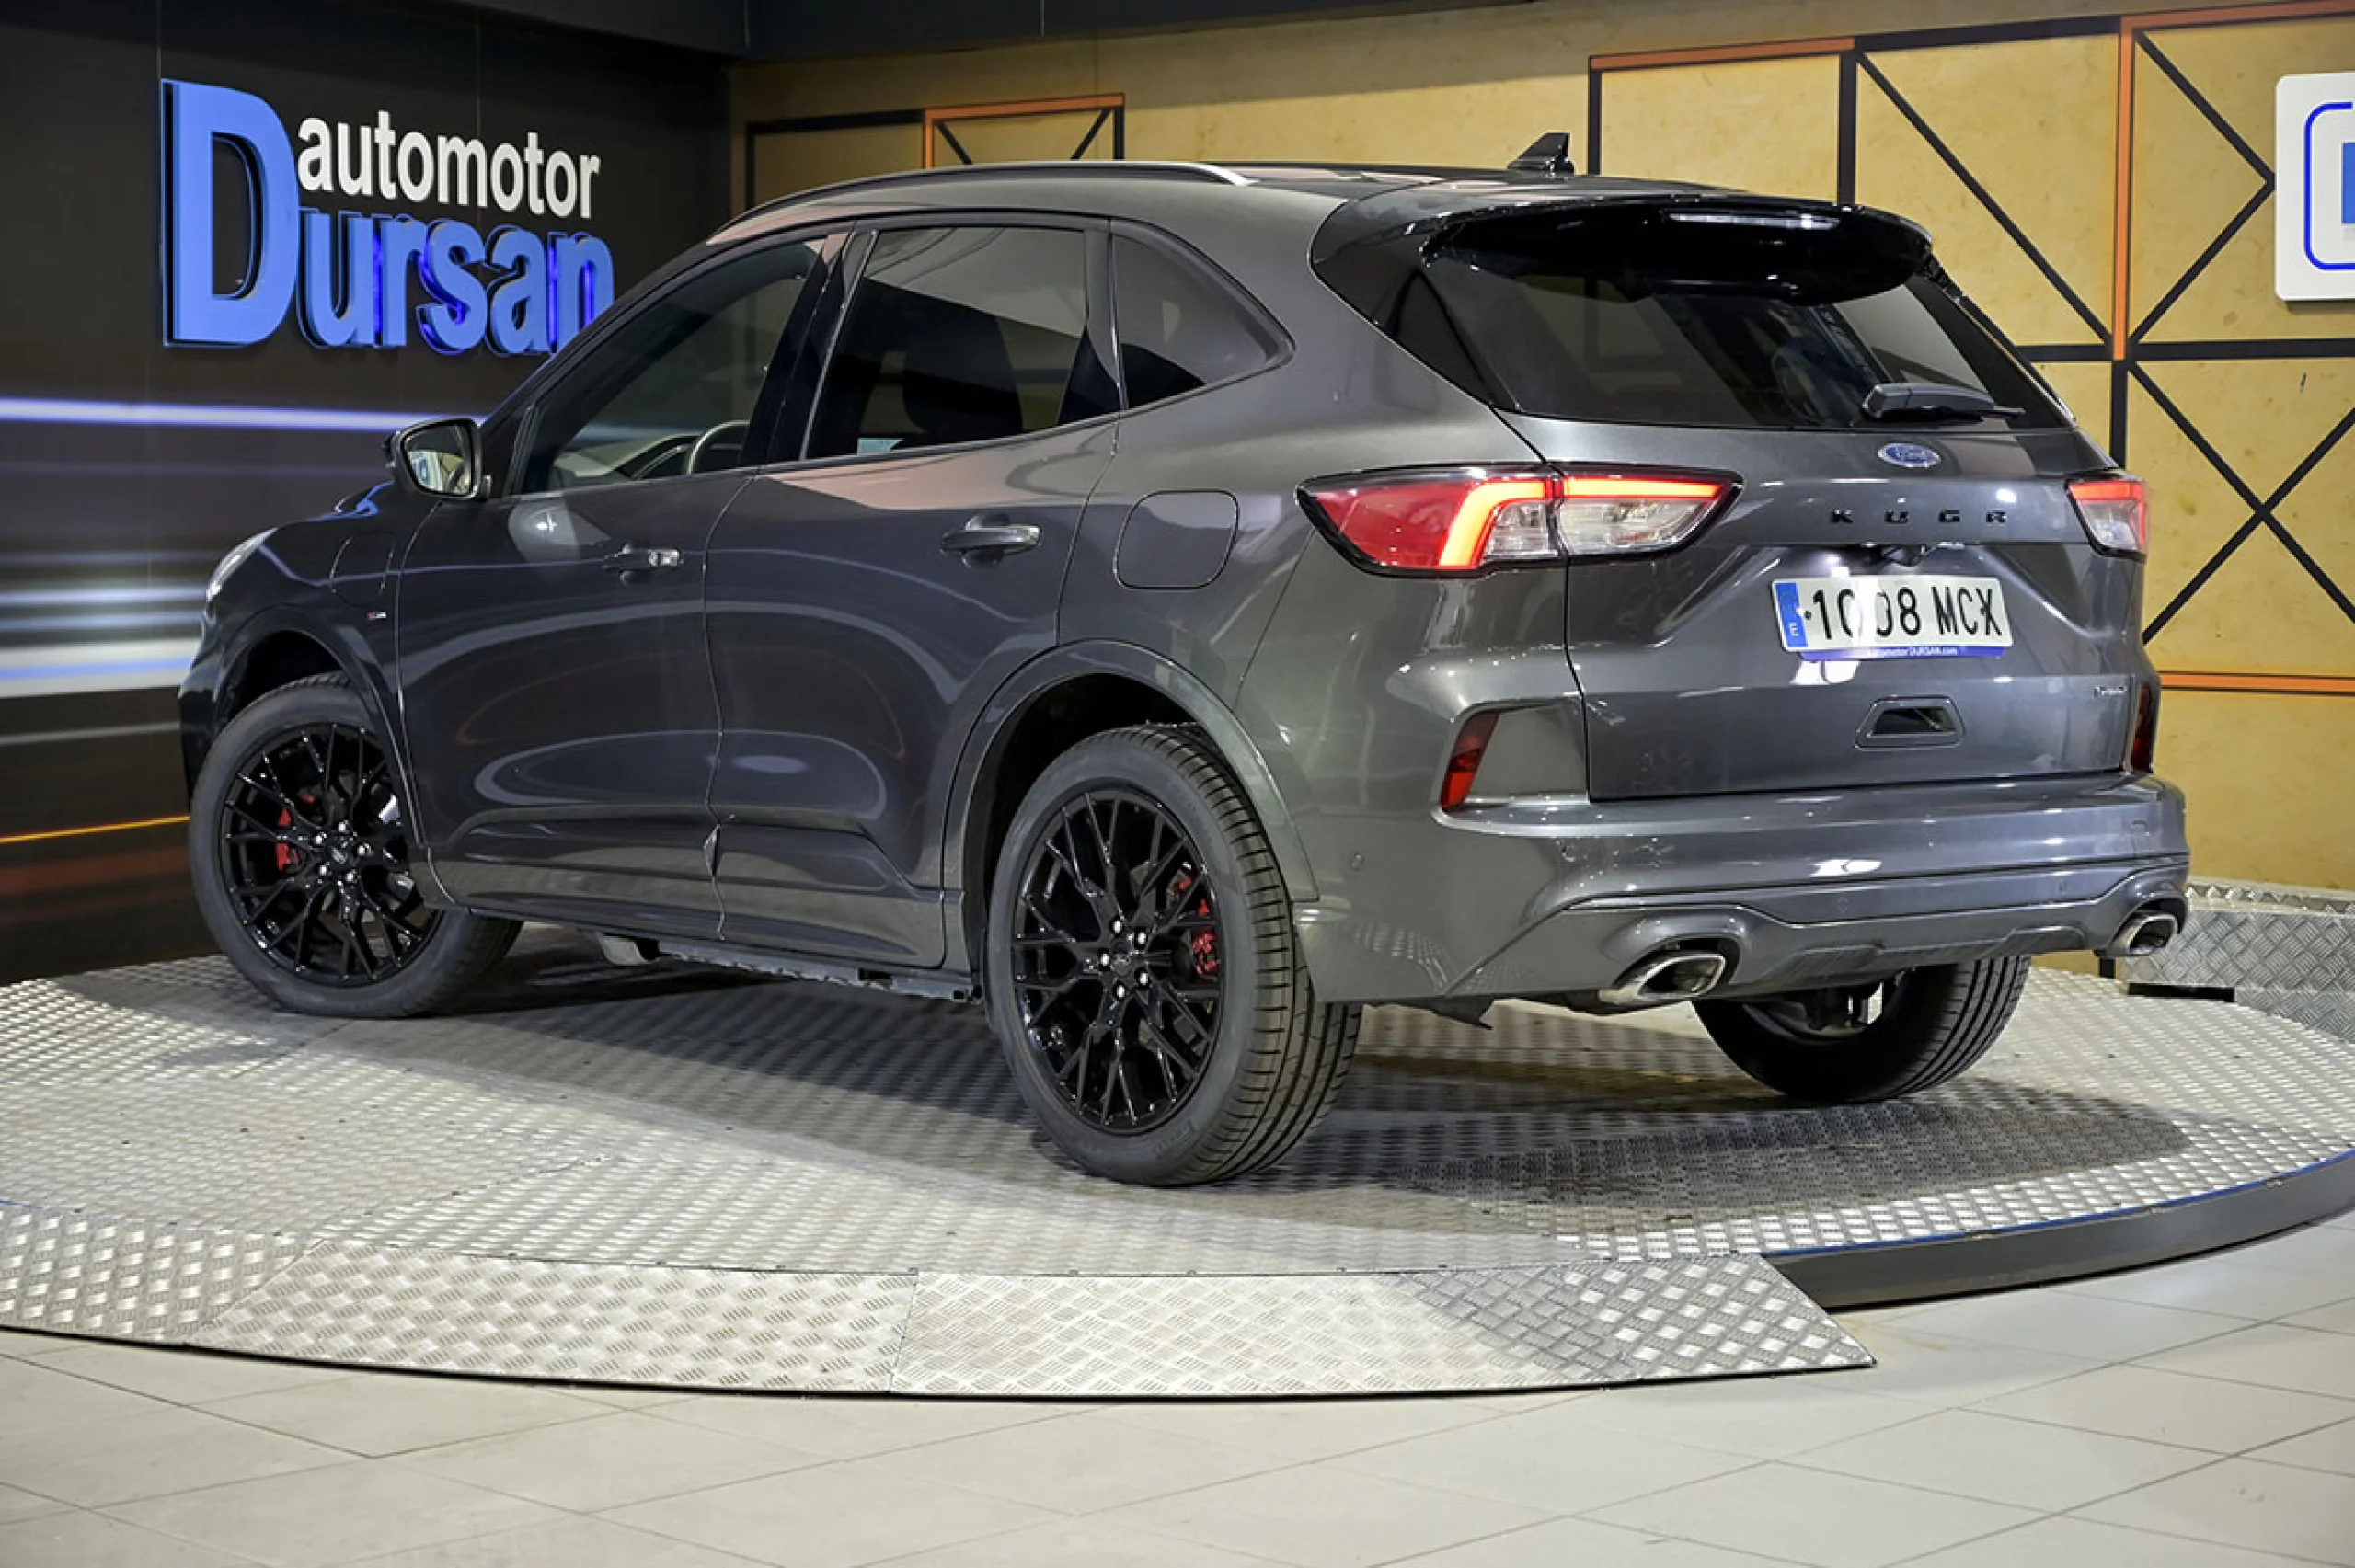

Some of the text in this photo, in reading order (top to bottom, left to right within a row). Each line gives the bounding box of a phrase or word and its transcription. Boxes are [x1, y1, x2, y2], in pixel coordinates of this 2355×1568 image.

[297, 110, 601, 219] automotor
[160, 77, 615, 356] Dursan
[1789, 622, 1799, 636] E
[1931, 586, 2003, 636] MCX
